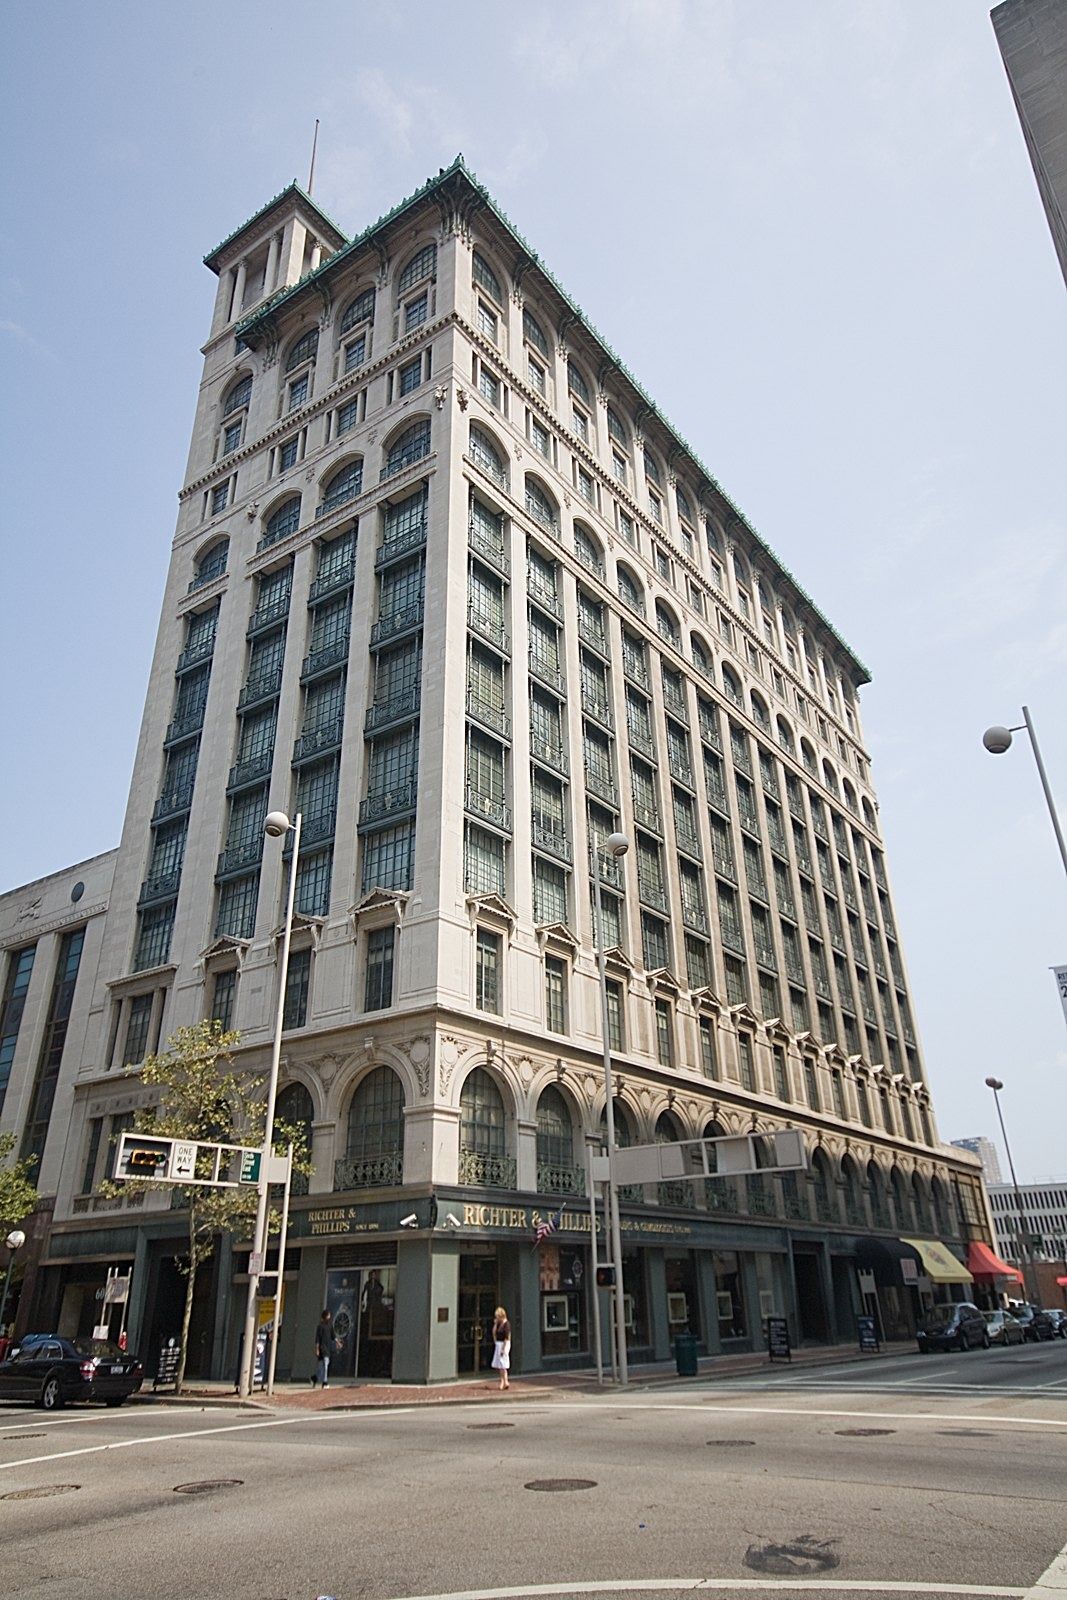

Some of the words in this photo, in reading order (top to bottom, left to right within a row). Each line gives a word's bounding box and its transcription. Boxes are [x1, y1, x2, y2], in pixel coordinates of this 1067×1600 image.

[178, 1147, 193, 1155] ONE
[177, 1156, 192, 1165] WAY
[308, 1208, 345, 1222] RICHTER
[348, 1208, 357, 1219] &
[463, 1204, 527, 1228] RICHTER
[531, 1210, 542, 1228] &
[311, 1221, 350, 1235] PHILLIPS
